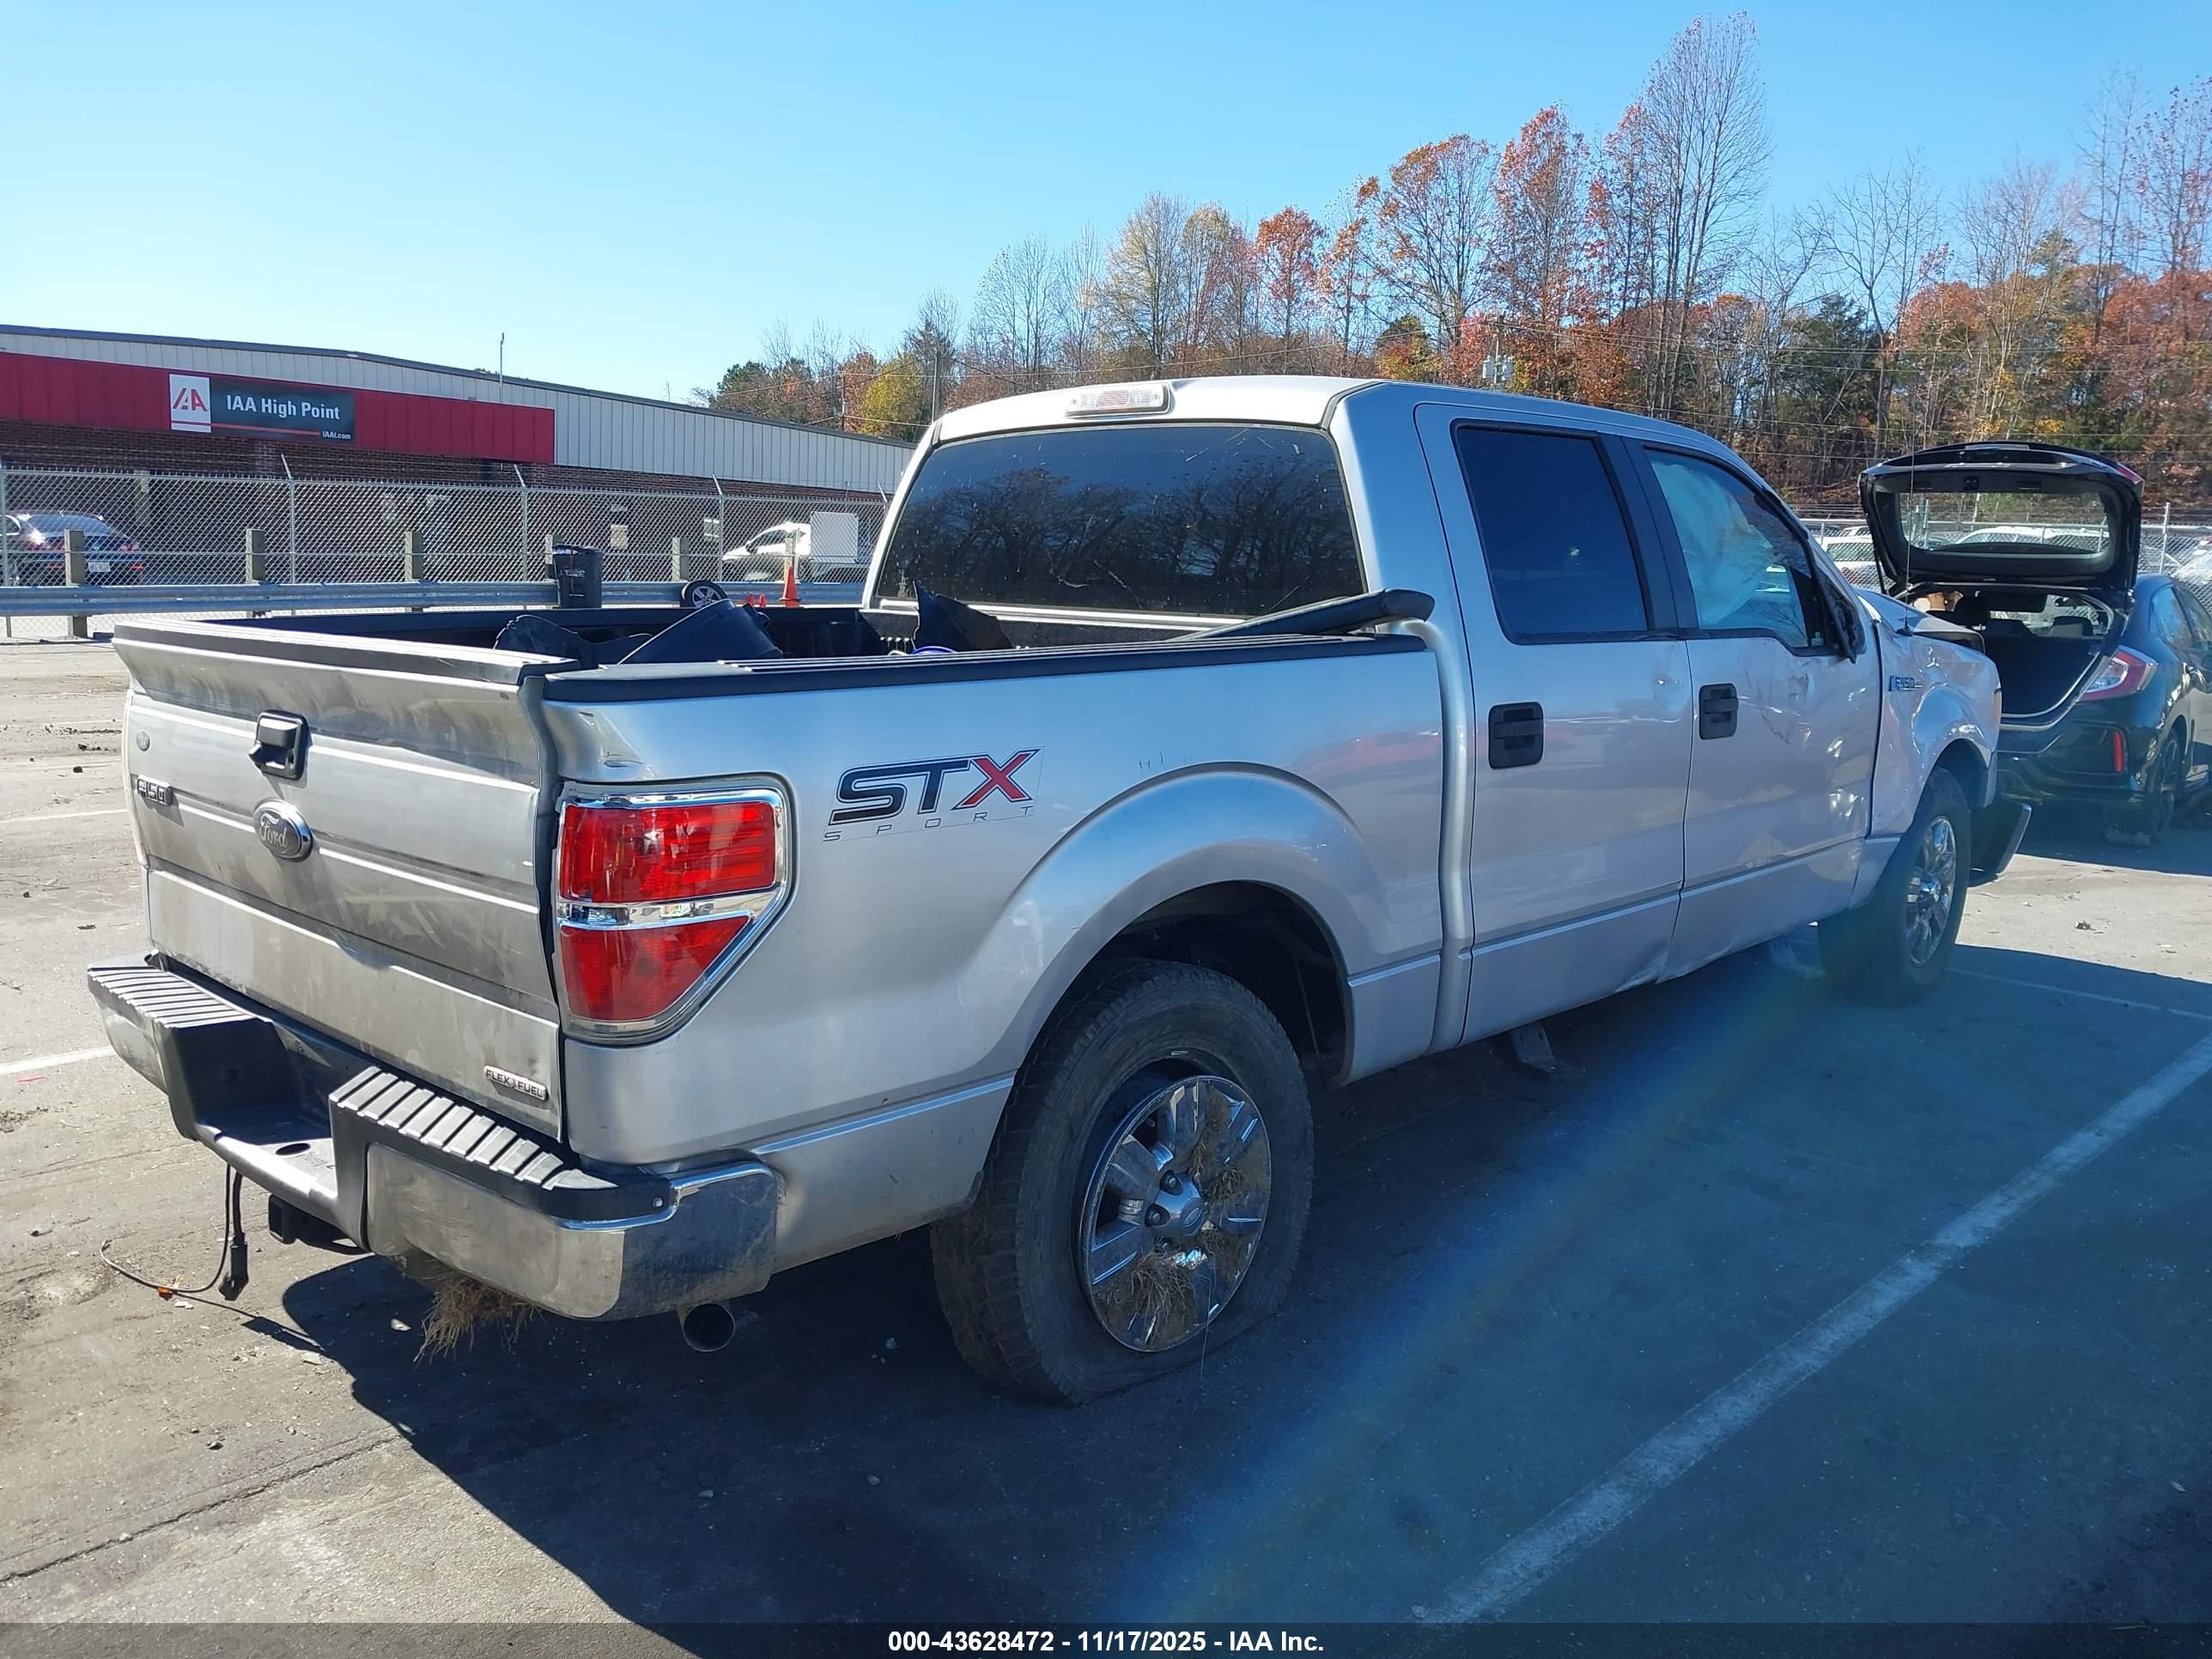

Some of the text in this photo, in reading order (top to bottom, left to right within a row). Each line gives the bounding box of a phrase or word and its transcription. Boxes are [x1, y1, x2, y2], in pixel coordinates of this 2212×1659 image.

[227, 394, 340, 420] IAA High Point
[828, 748, 1042, 826] STX
[260, 811, 289, 848] Ford
[823, 805, 1034, 842] SPORT
[485, 1069, 544, 1098] FLEX FUEL
